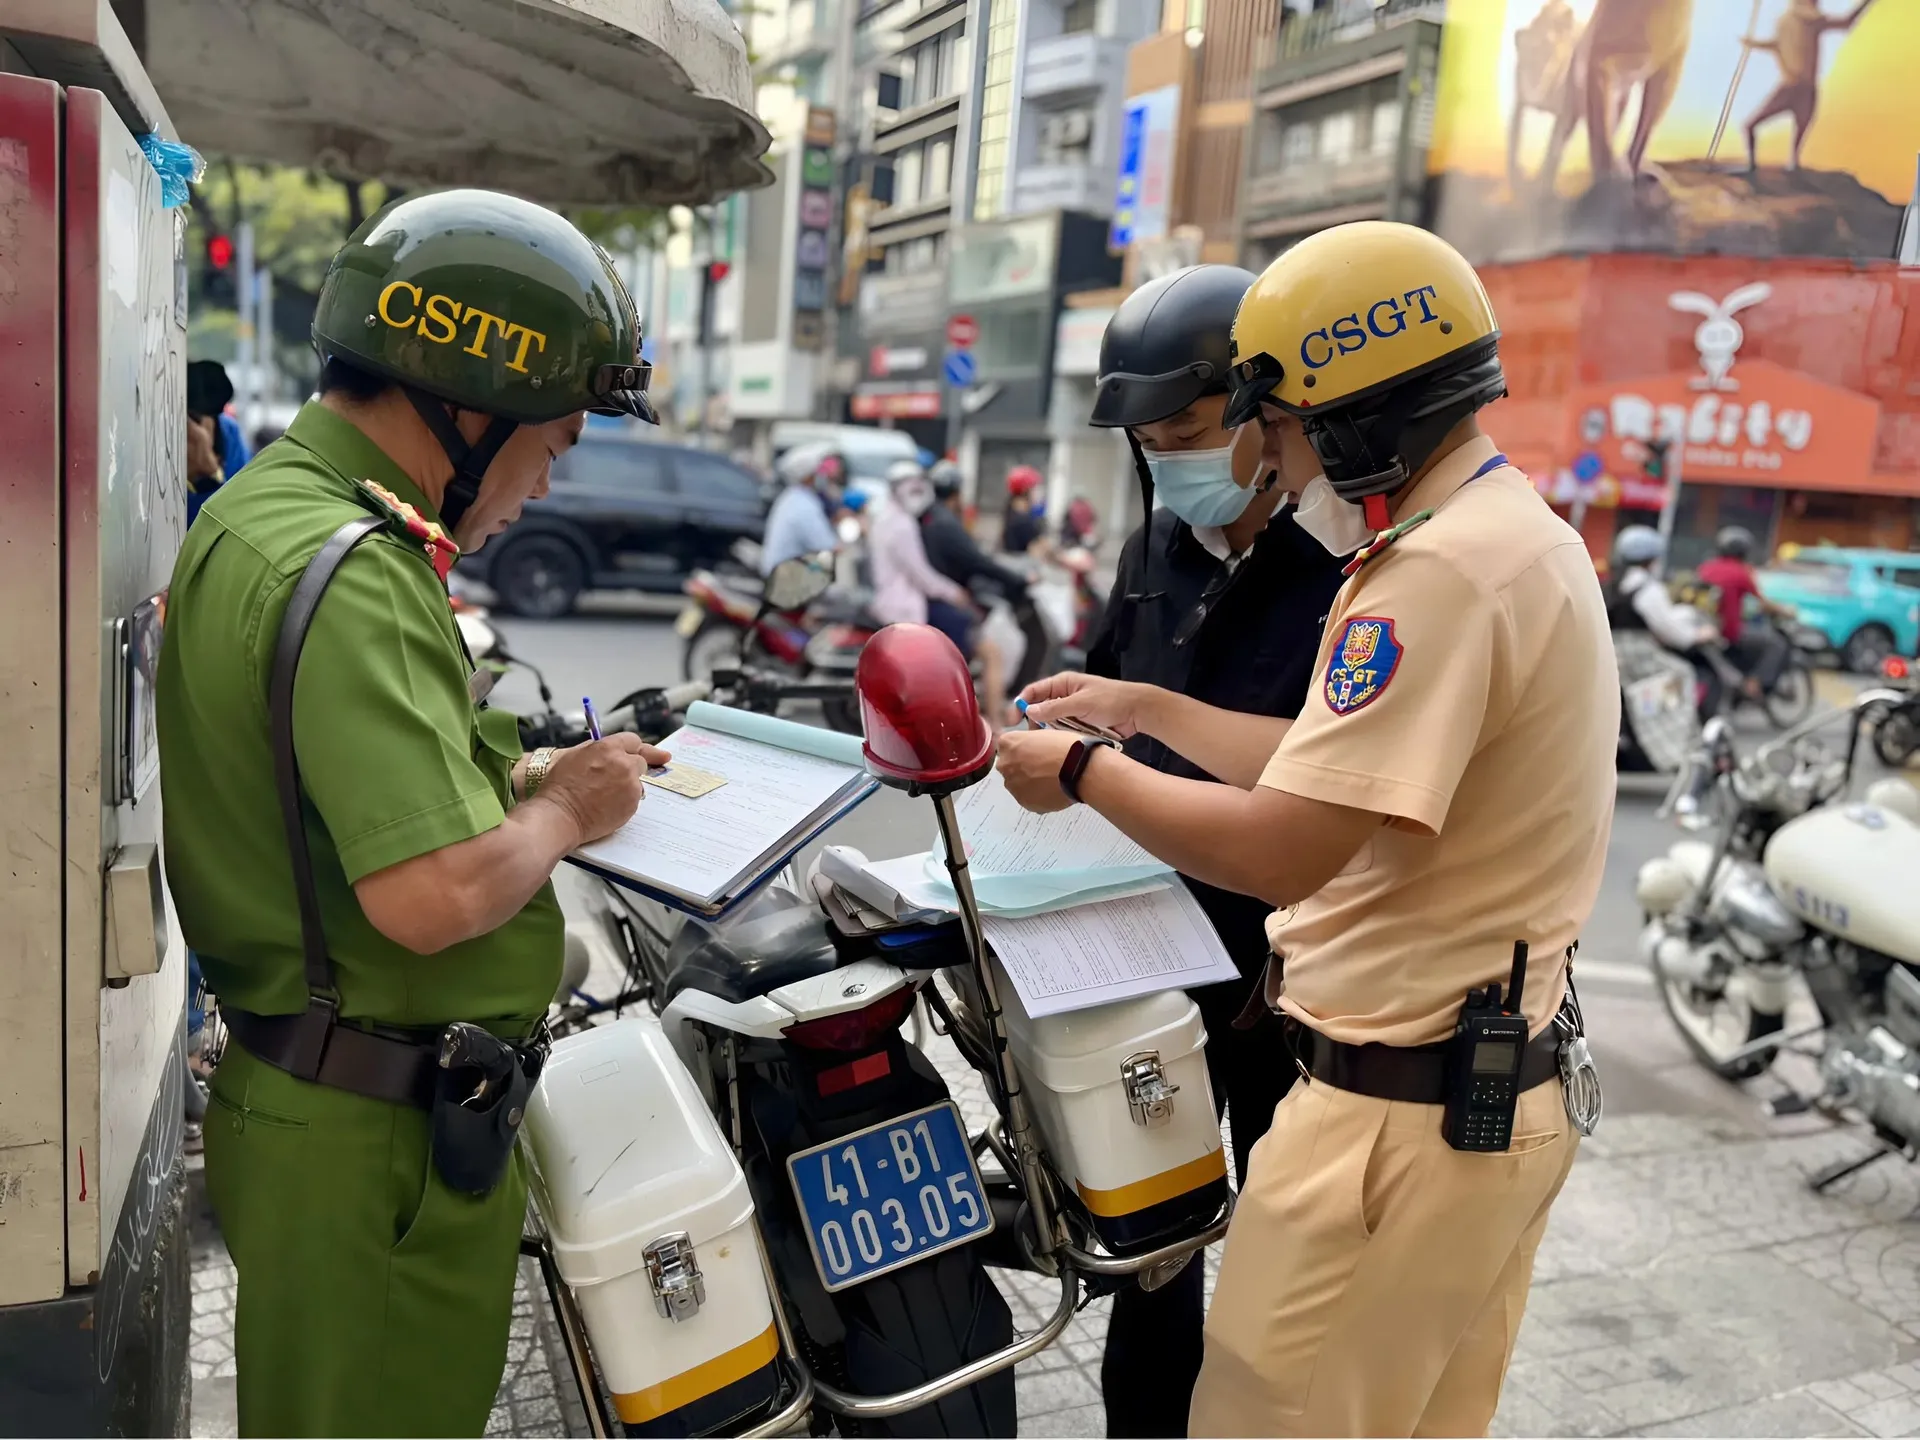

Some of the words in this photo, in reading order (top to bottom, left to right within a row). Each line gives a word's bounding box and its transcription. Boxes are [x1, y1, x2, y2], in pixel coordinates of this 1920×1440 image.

[378, 280, 547, 374] CSTT
[1300, 285, 1439, 369] CSGT
[821, 1171, 980, 1276] 003.05
